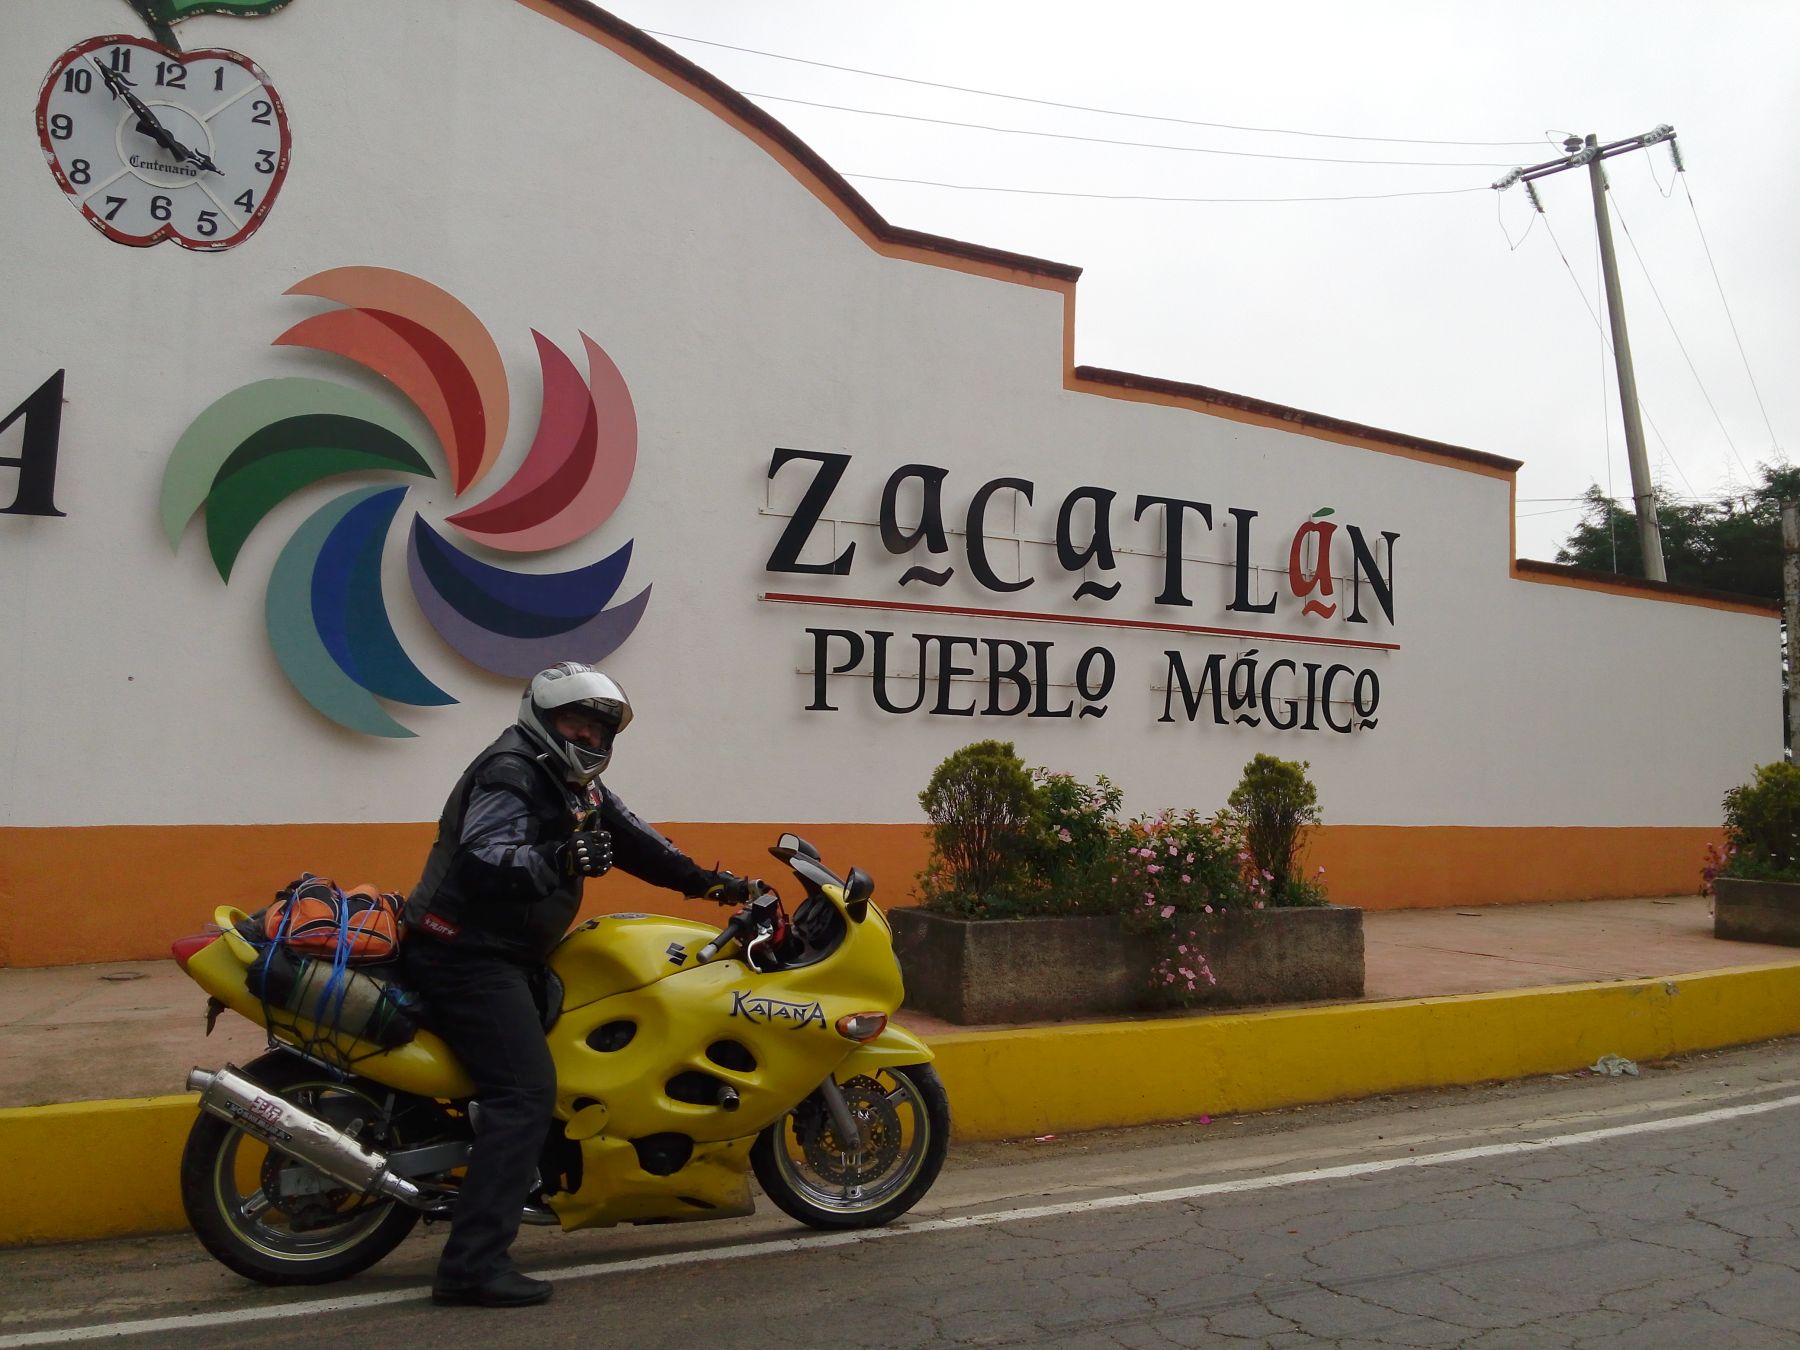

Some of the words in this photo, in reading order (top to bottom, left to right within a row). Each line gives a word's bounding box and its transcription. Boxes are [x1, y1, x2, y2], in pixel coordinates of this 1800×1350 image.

[112, 47, 131, 73] 11
[64, 68, 91, 94] 10
[155, 62, 187, 90] 12
[214, 67, 224, 90] 1
[252, 101, 272, 125] 2
[51, 114, 72, 140] 9
[70, 159, 90, 184] 8
[129, 154, 197, 177] Centenario
[255, 150, 275, 173] 3
[105, 196, 127, 220] 7
[151, 196, 172, 220] 6
[234, 189, 254, 213] 4
[197, 211, 218, 236] 5
